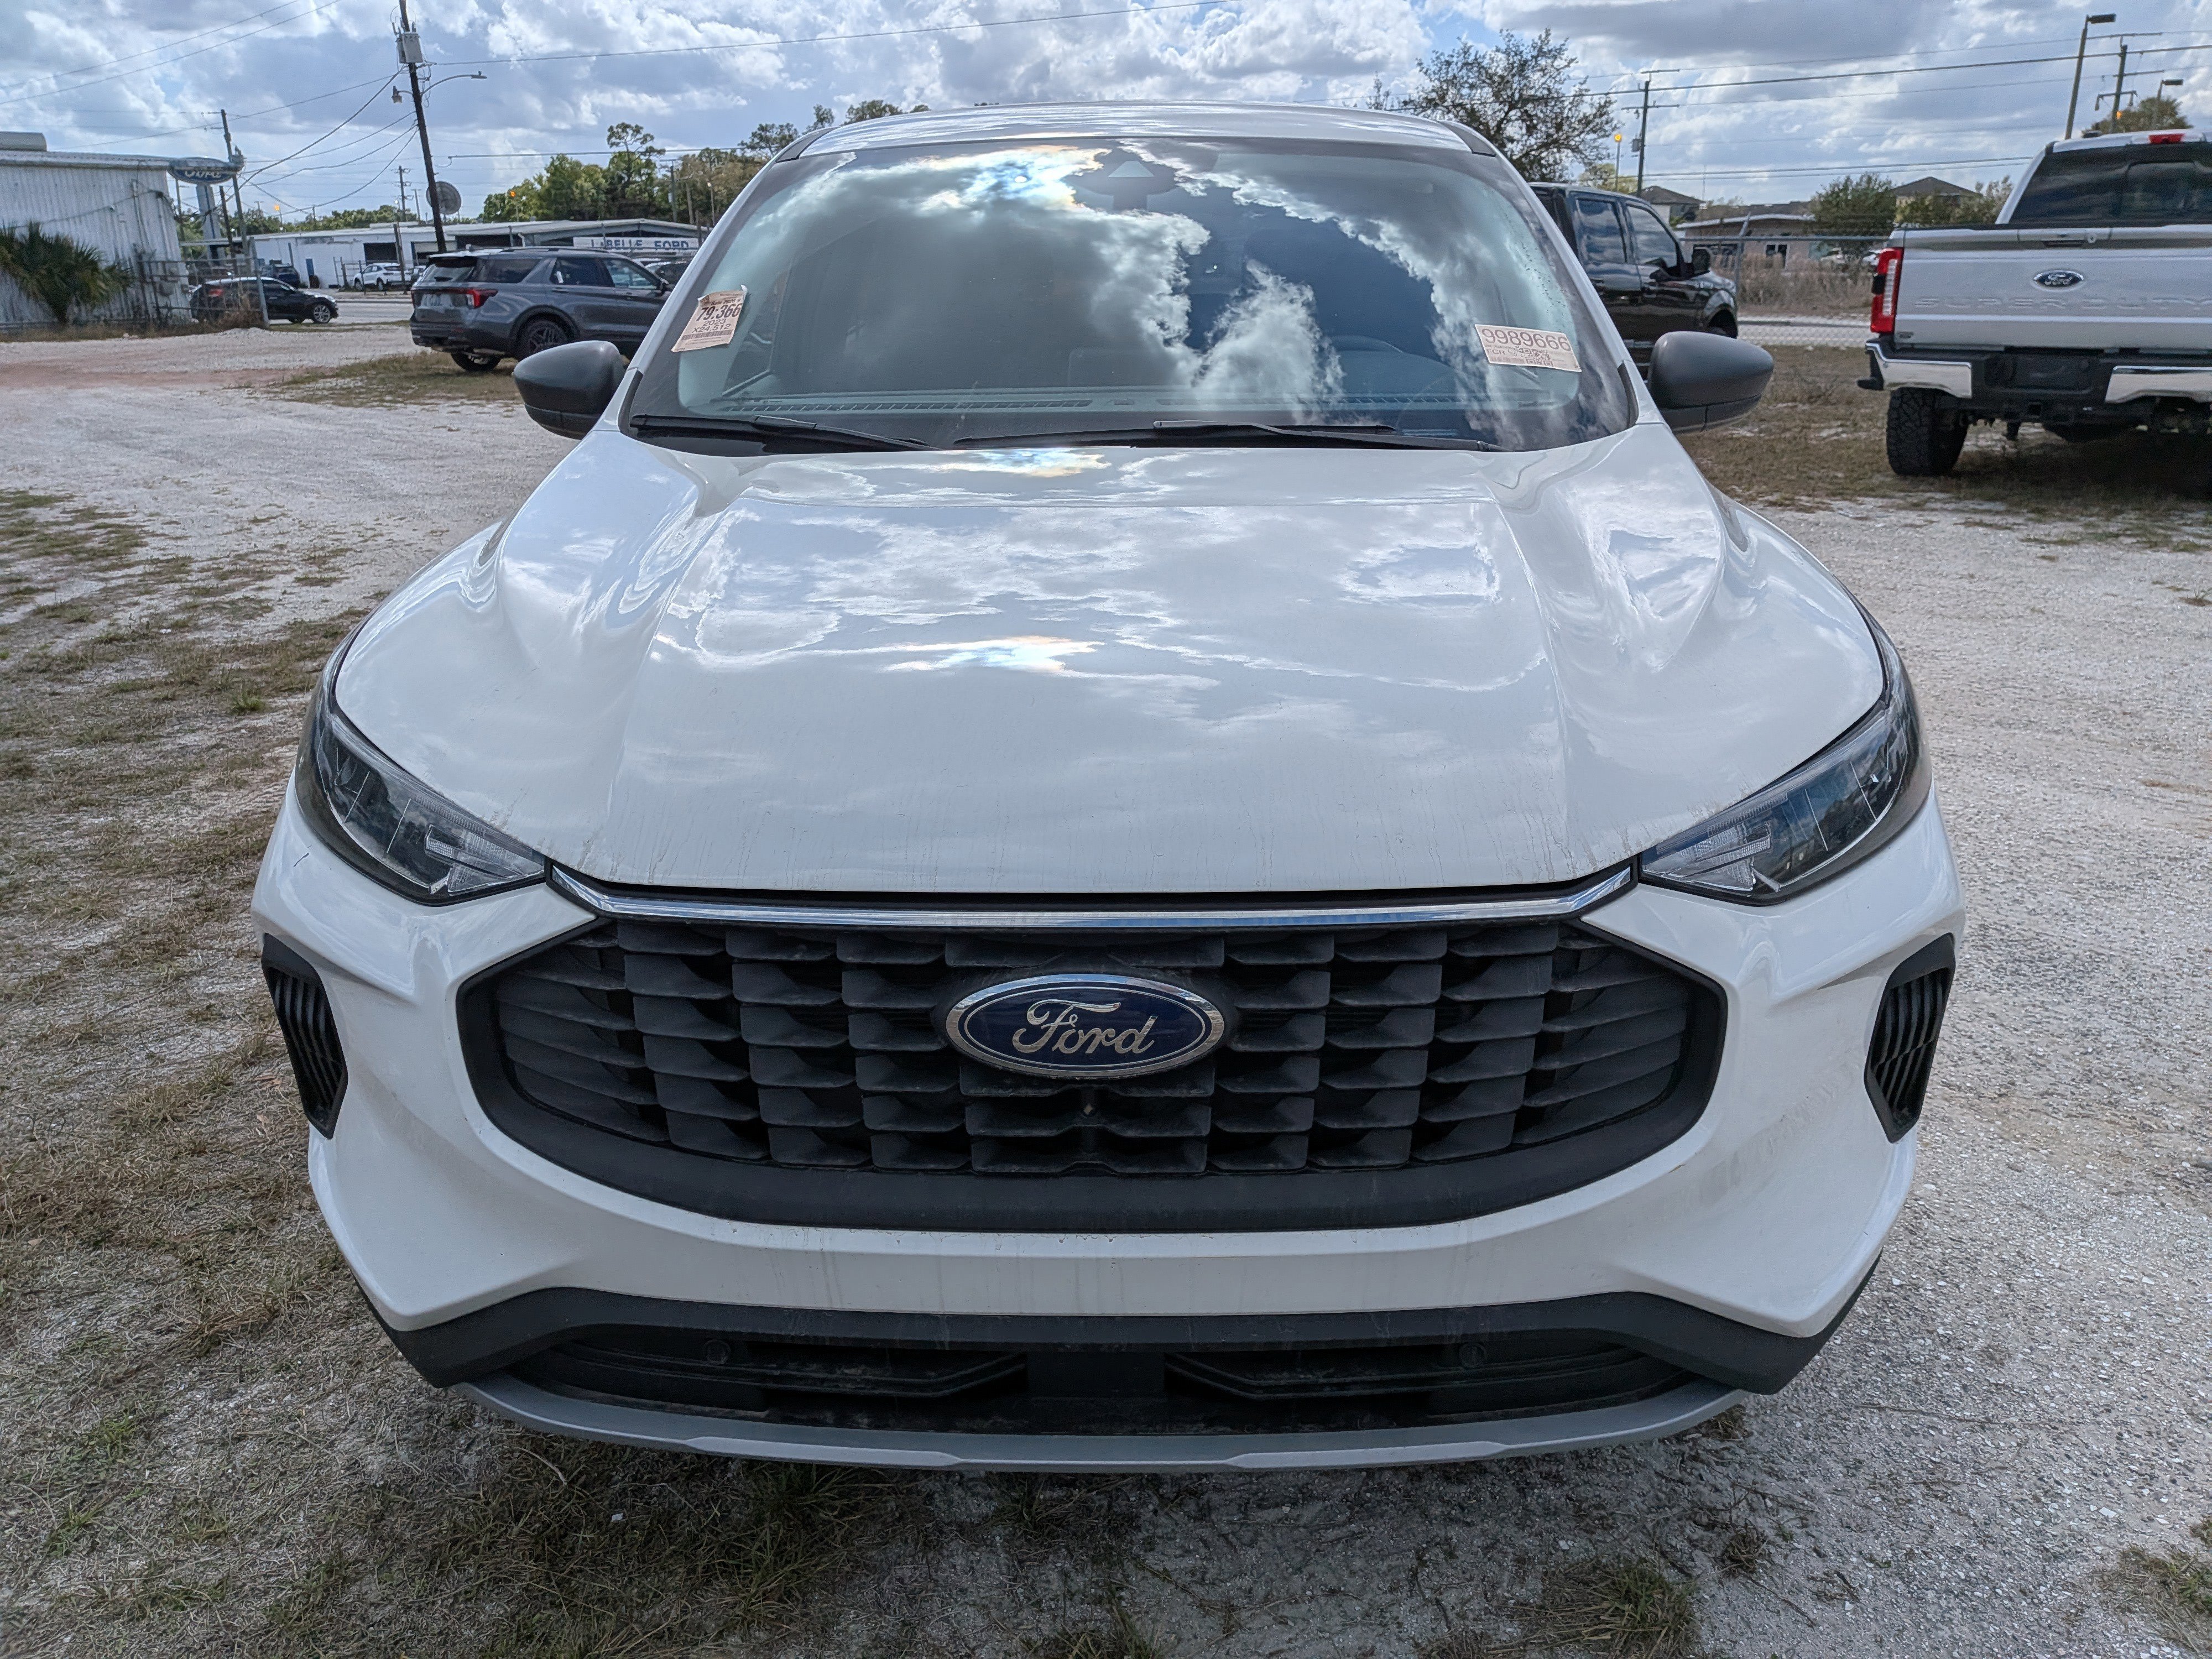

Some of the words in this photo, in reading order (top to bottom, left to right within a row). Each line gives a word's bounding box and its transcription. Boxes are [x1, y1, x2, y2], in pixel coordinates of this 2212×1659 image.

[2044, 273, 2074, 285] Ford
[1914, 297, 2066, 309] SUPER
[696, 302, 742, 322] 79:366
[702, 318, 727, 326] 2023
[1481, 328, 1572, 352] 9989666
[1011, 998, 1159, 1055] Ford
